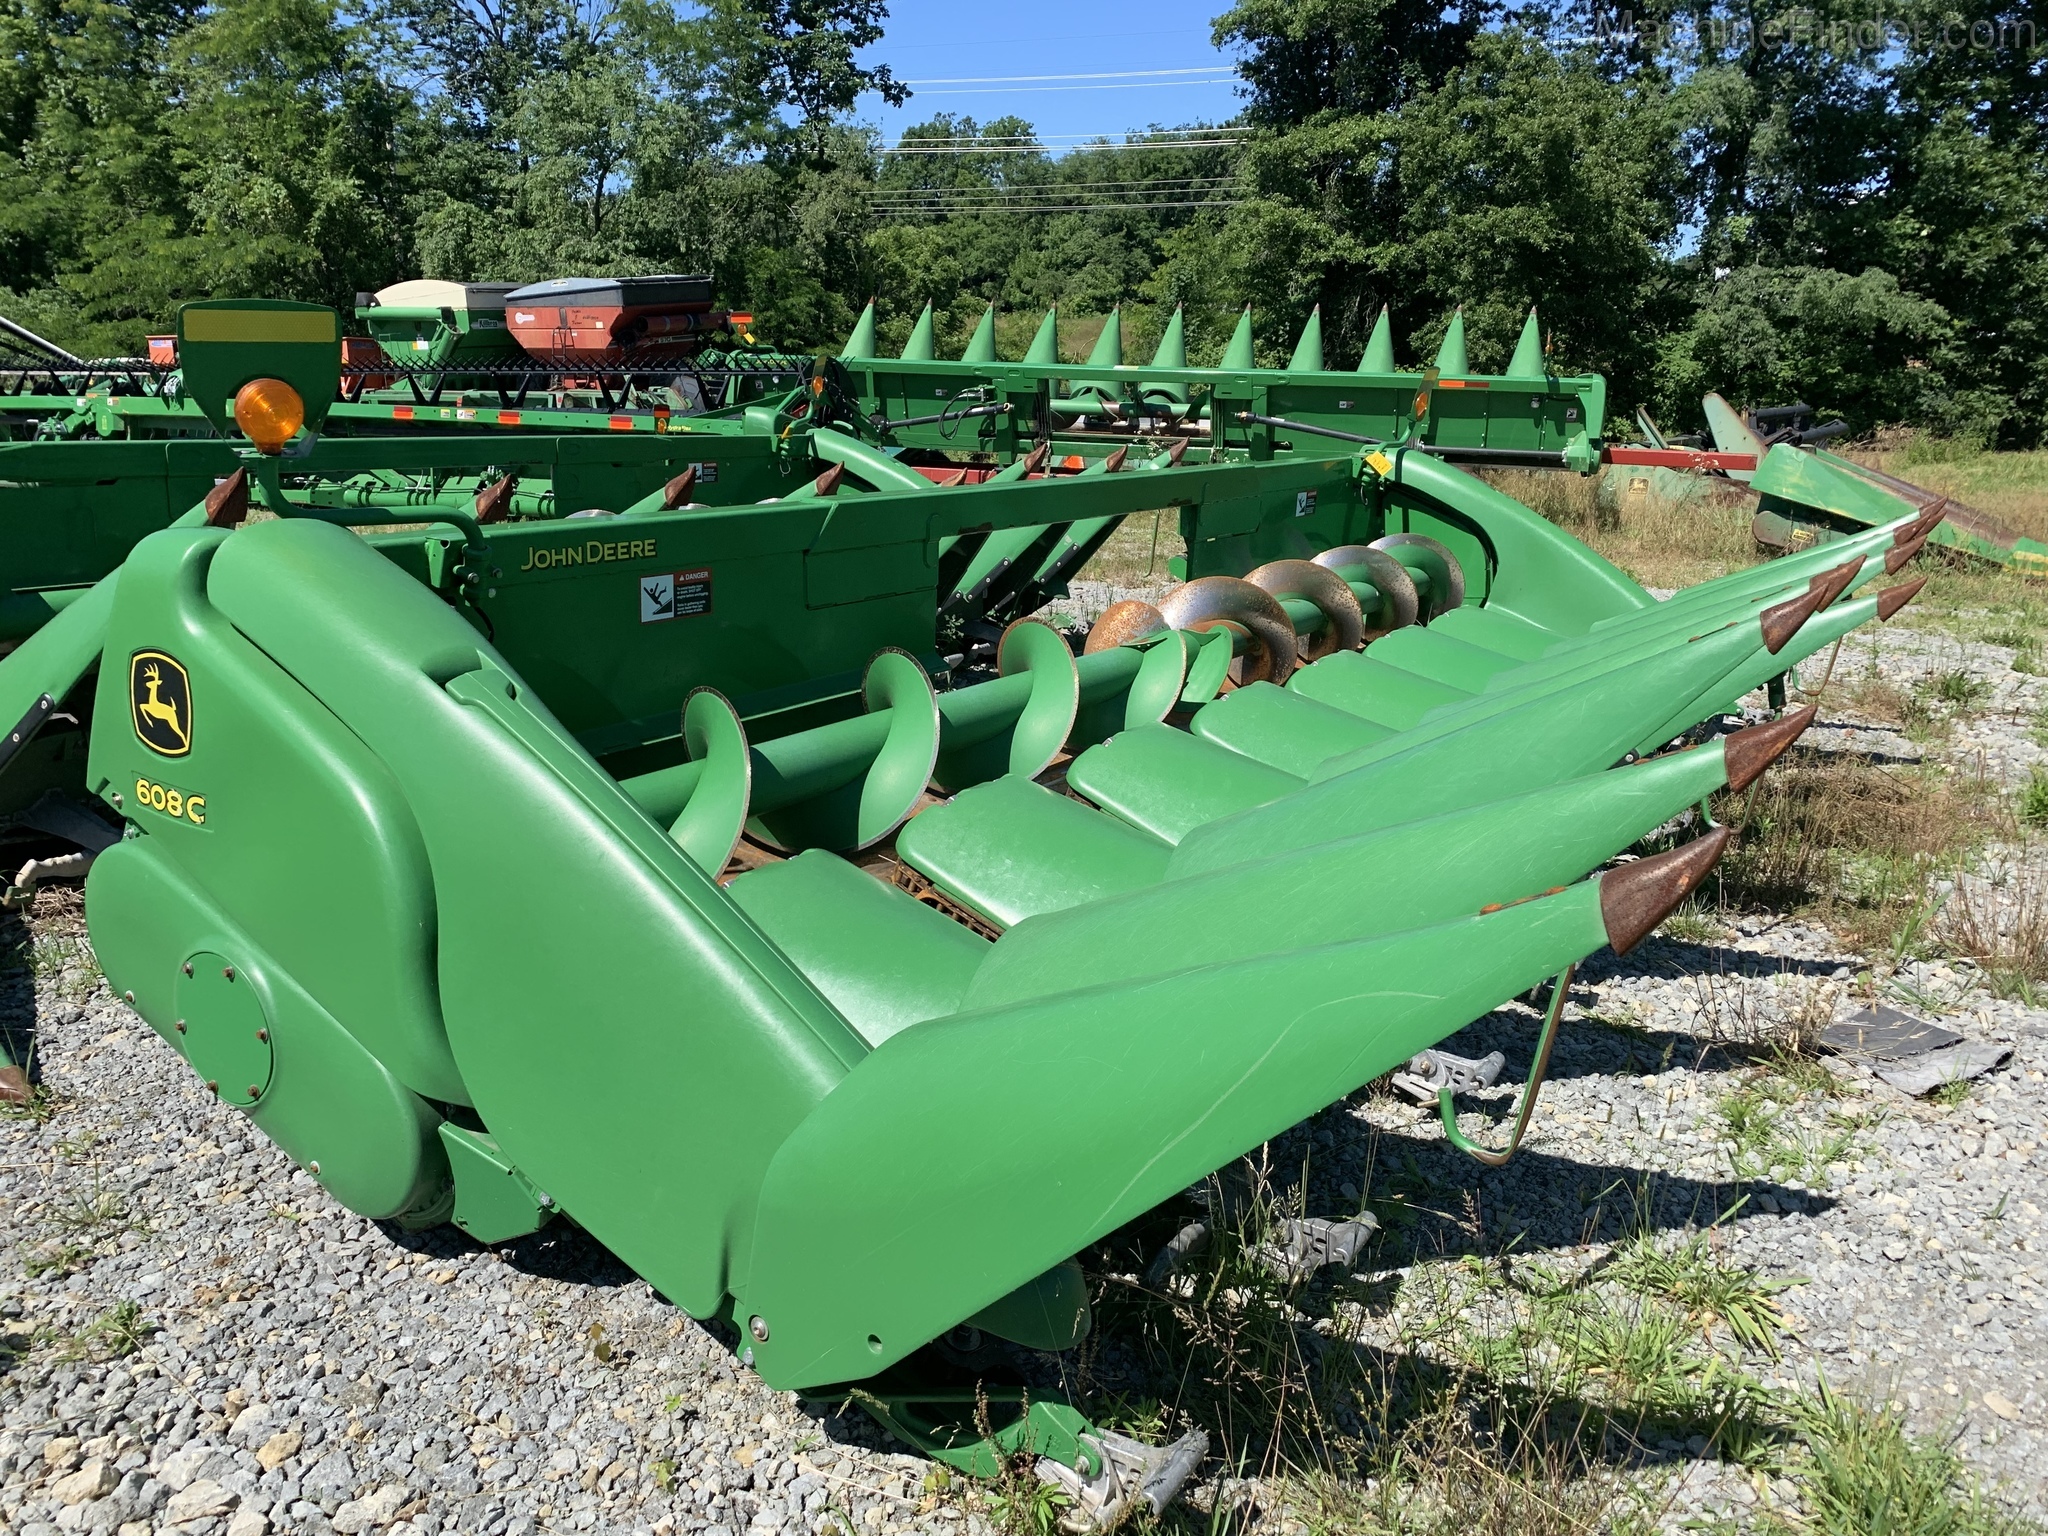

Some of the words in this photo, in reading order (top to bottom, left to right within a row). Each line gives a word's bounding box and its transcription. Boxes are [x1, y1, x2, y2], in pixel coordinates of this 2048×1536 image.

[520, 546, 583, 571] JOHN
[586, 539, 657, 564] DEERE
[685, 571, 709, 581] DANGER
